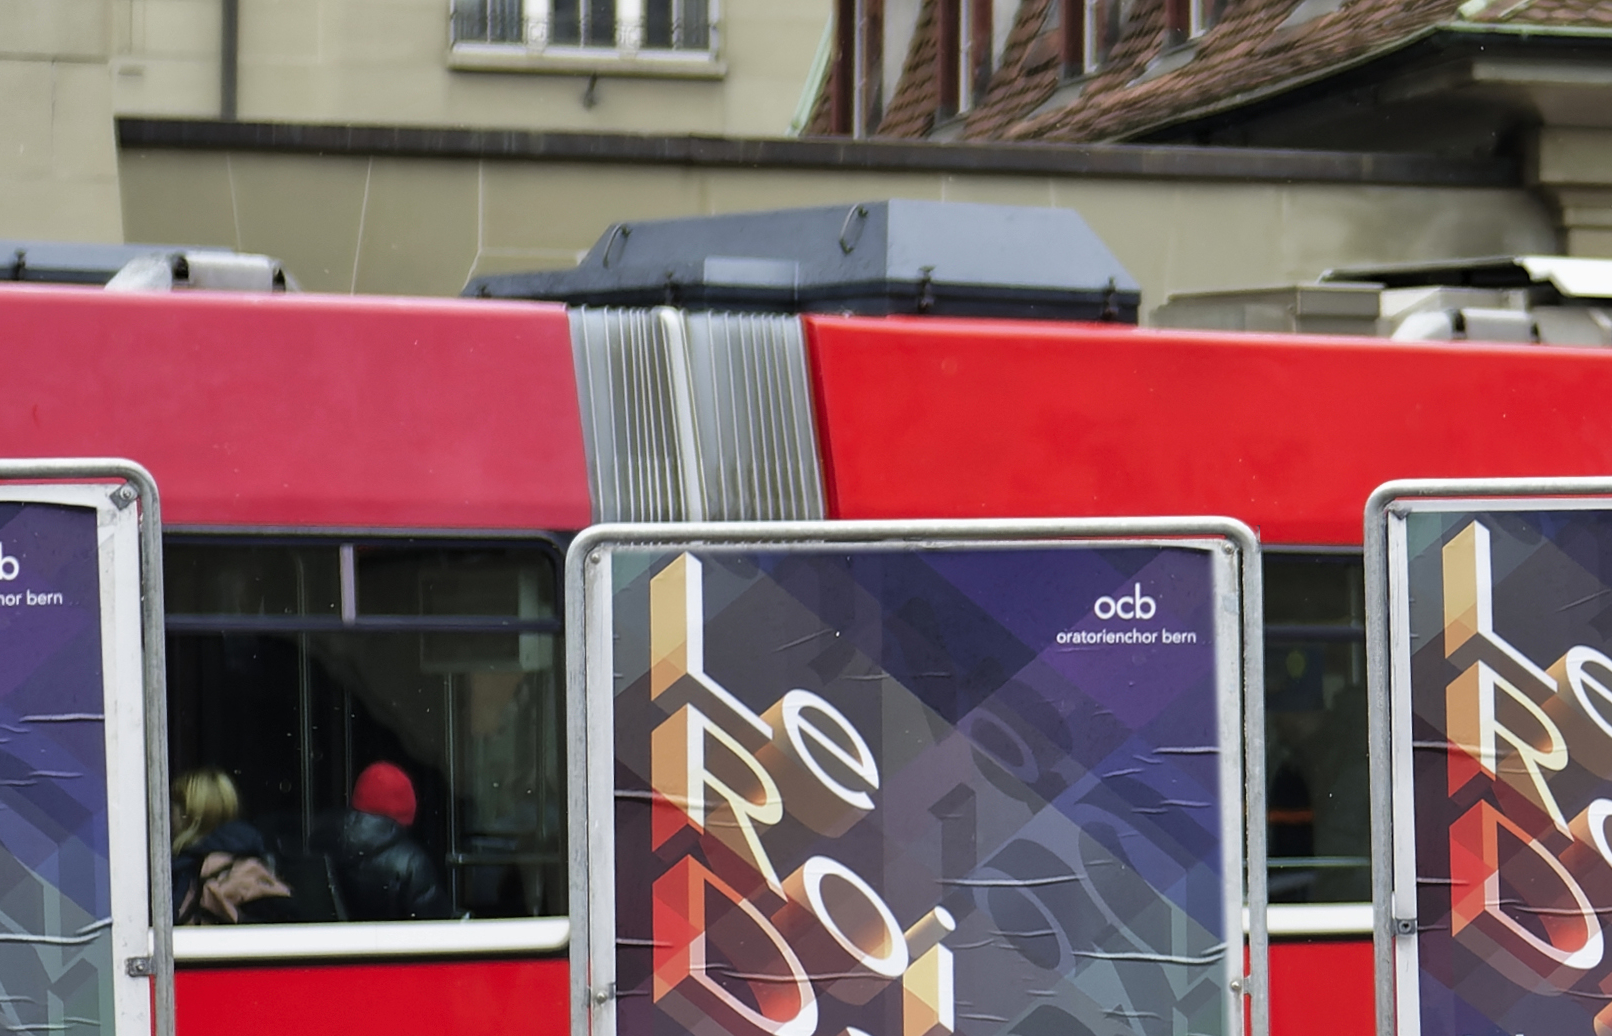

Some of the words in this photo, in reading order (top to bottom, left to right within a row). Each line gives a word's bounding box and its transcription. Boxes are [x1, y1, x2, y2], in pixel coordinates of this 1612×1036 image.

[26, 589, 63, 605] bern
[1093, 582, 1156, 620] ocb
[1056, 627, 1158, 644] oratorienchor
[1161, 628, 1197, 644] bern
